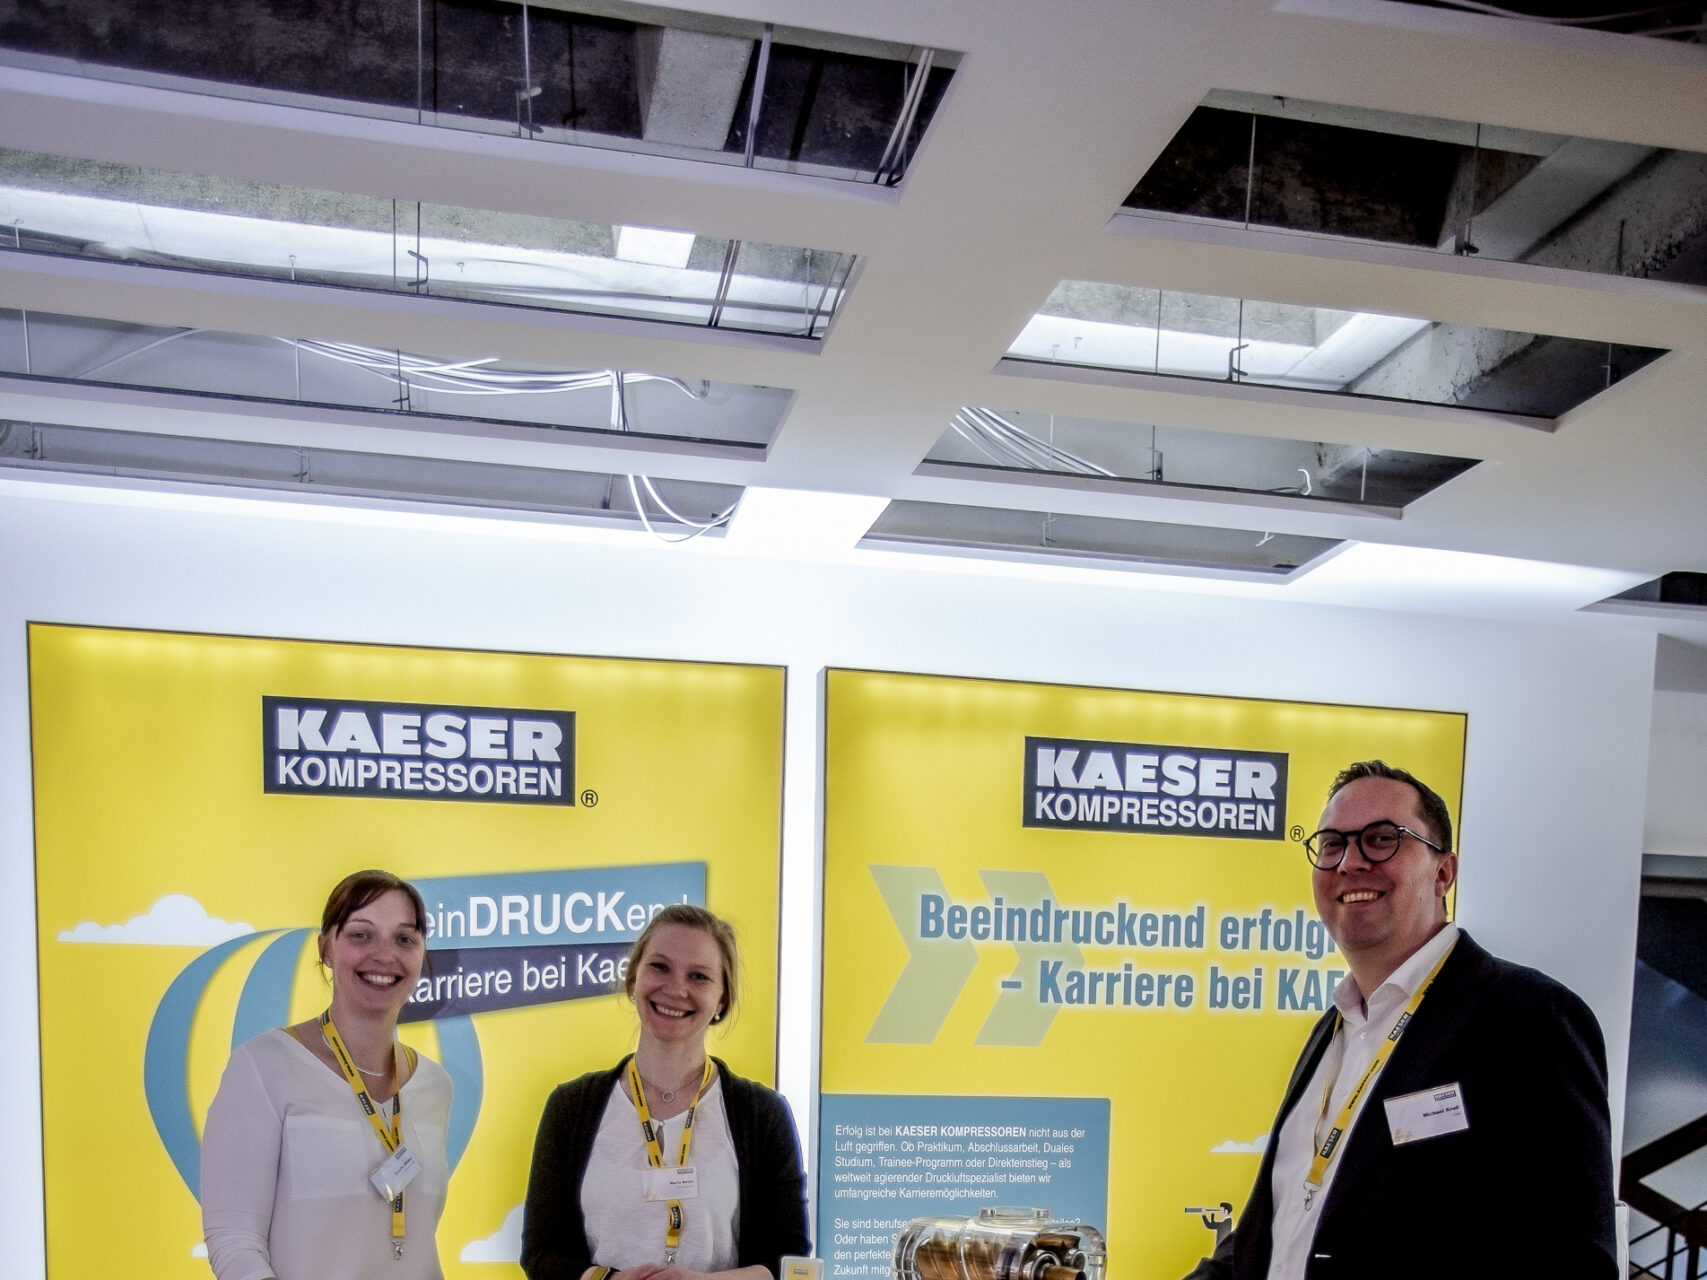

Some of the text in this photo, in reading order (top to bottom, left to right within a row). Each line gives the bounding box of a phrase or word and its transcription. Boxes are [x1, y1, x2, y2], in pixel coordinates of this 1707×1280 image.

[278, 708, 563, 762] KAESER
[278, 756, 562, 796] KOMPRESSOREN
[1037, 747, 1277, 800] KAESER
[1035, 791, 1275, 832] KOMPRESSOREN
[920, 893, 1205, 948] Beeindruckend
[408, 953, 631, 1003] arriere bei Kae
[1039, 960, 1194, 1008] Karriere
[1209, 965, 1262, 1010] bei
[835, 1125, 1085, 1138] Erfolg ist bei KAESER KOMPRESSOREN nicht aus der
[835, 1141, 1074, 1154] Luft gegriffen. Ob Praktikum, Abschlussarbeit, Duales
[835, 1156, 875, 1168] Studium,
[879, 1157, 963, 1170] Trainee-Programm
[966, 1158, 985, 1168] oder
[989, 1157, 1048, 1170] Direkteinstieg
[1058, 1158, 1071, 1168] als
[835, 1172, 1051, 1185] weltweit agierender Druckluftspezialist bieten wir
[835, 1188, 999, 1201] umfangreiche Karrieremöglichkeiten.
[834, 1218, 909, 1229] Sie sind berufse
[834, 1234, 857, 1244] Oder
[860, 1234, 888, 1244] haben
[834, 1250, 891, 1262] den perfekte
[834, 1265, 890, 1277] Zukunft mitg
